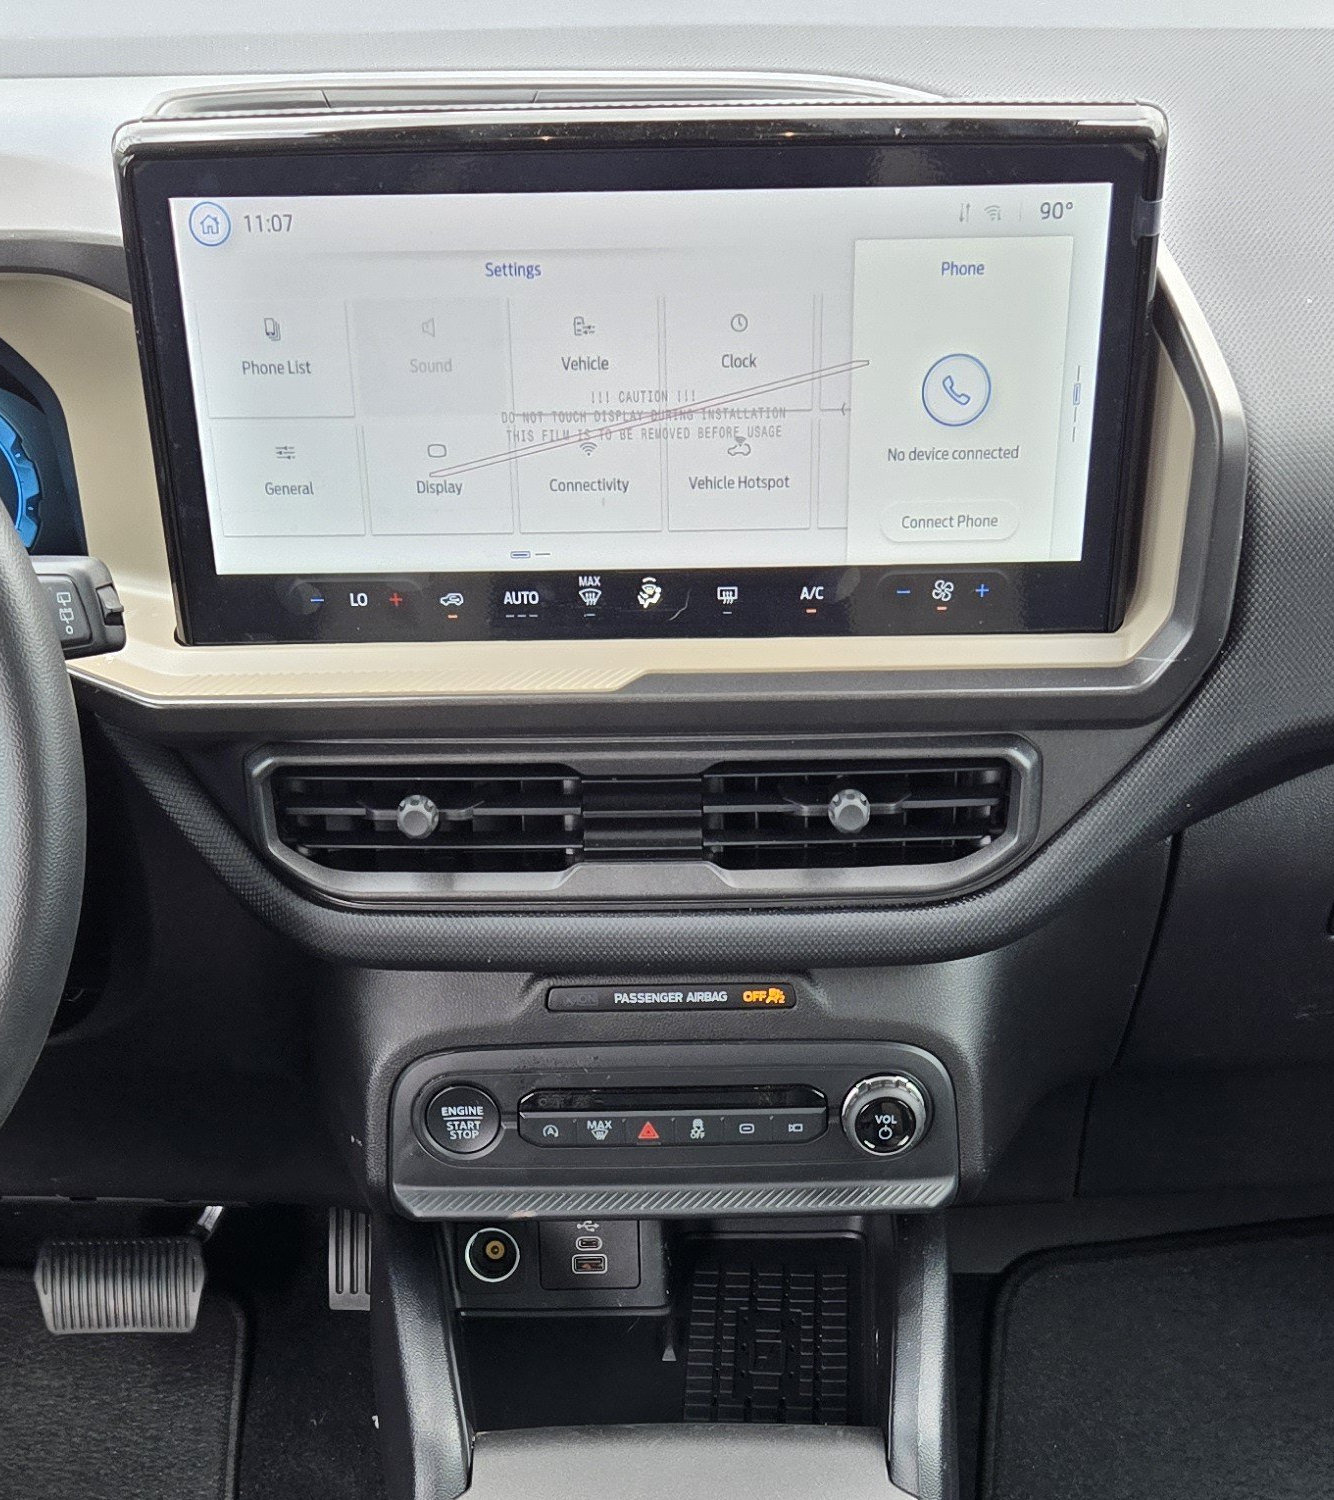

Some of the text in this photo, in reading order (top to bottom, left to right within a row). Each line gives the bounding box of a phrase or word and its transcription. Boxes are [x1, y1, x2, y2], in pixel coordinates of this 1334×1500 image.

[1039, 201, 1074, 221] 90°
[243, 214, 293, 233] 11:07
[485, 261, 542, 279] Settings
[941, 260, 985, 277] Phone
[241, 359, 312, 376] Phone List
[409, 357, 452, 374] Sound
[561, 355, 610, 372] Vehicle
[721, 353, 757, 370] Clock
[618, 390, 668, 403] CAUTION
[501, 407, 786, 424] DO NOT TOUCH DISPLAY DURING INSTALLATION
[506, 425, 782, 442] THIS FILM IS TO BE REMOVED BEFORE USAGE
[887, 445, 1019, 462] No device connected
[264, 481, 315, 497] General
[416, 479, 463, 497] Display
[549, 477, 630, 496] Connectivity
[688, 475, 790, 493] Vehicle Hotspot
[901, 512, 998, 531] Connect Phone
[578, 576, 601, 588] MAX
[349, 592, 368, 607] LO
[503, 590, 539, 606] AUTO
[800, 585, 824, 601] A/C
[614, 990, 728, 1004] PASSENGER AIRBAG
[742, 990, 767, 1003] OFF
[441, 1106, 483, 1117] ENGINE
[874, 1115, 897, 1125] VOL
[446, 1121, 481, 1133] START
[587, 1120, 612, 1131] MAX
[450, 1129, 479, 1140] STOP
